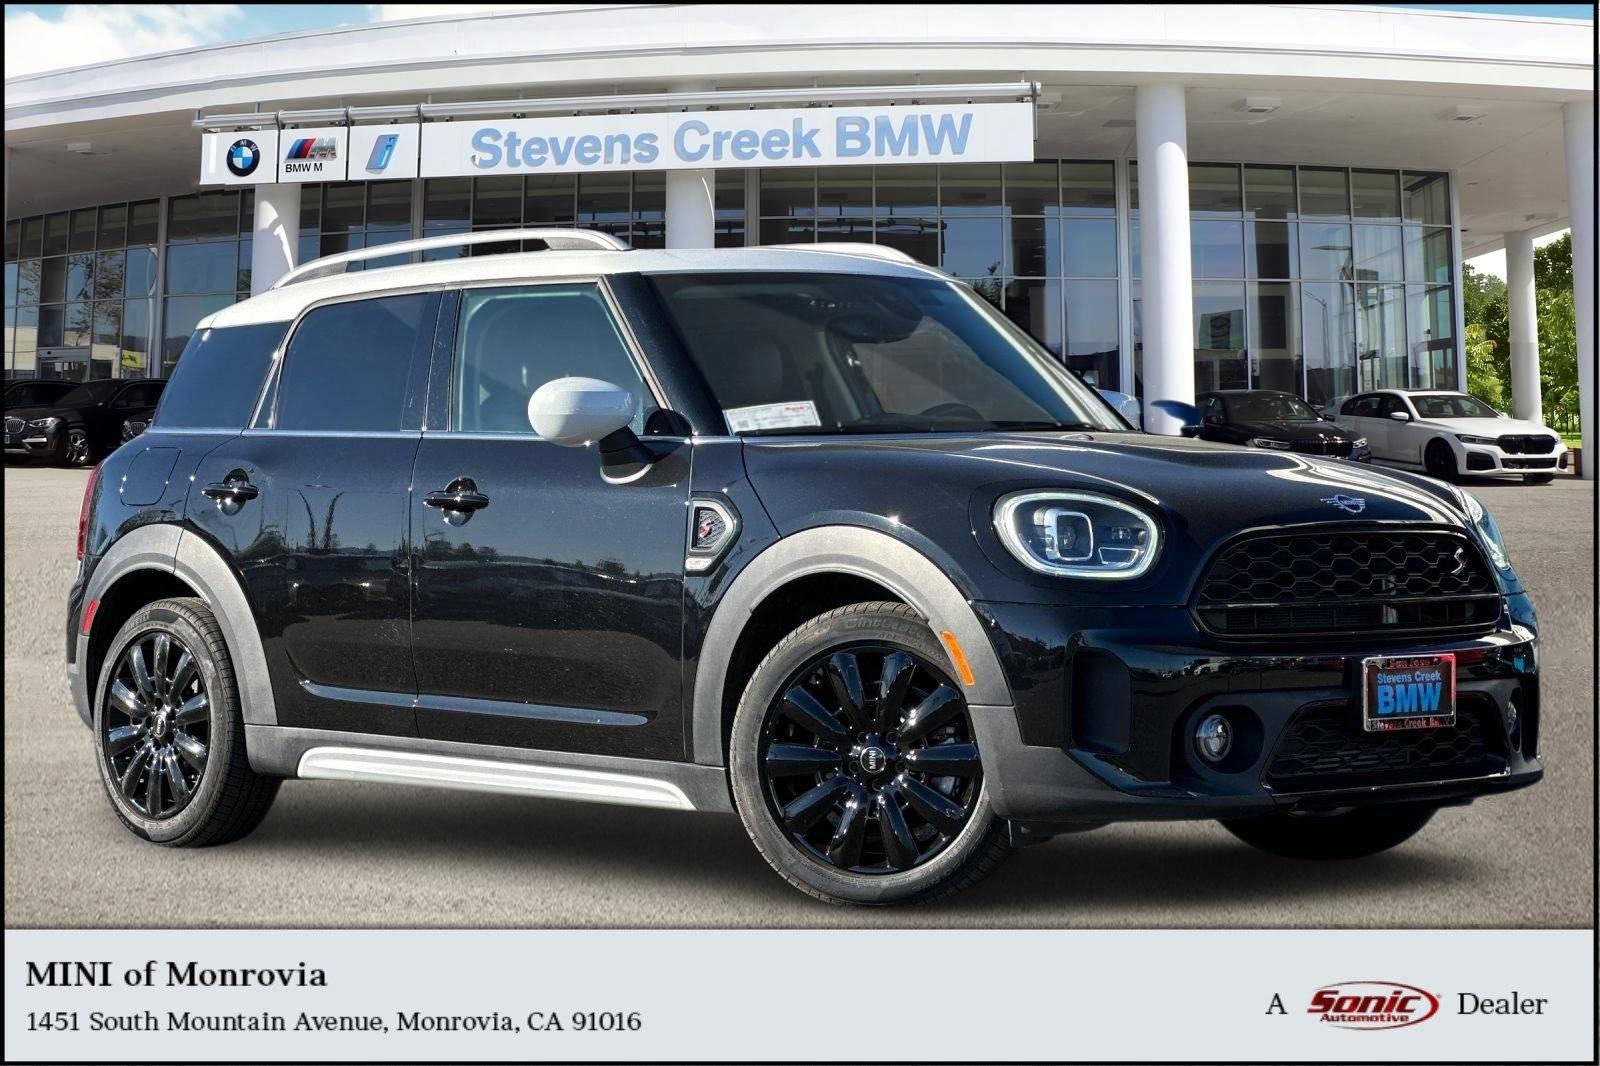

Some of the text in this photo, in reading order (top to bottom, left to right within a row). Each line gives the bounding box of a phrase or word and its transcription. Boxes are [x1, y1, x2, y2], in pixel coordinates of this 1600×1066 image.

[471, 113, 973, 169] Stevens Creek BMW
[285, 162, 323, 173] BMW M
[1377, 670, 1442, 684] Stevens Creek
[1378, 682, 1442, 714] BMW
[868, 750, 877, 770] MINI
